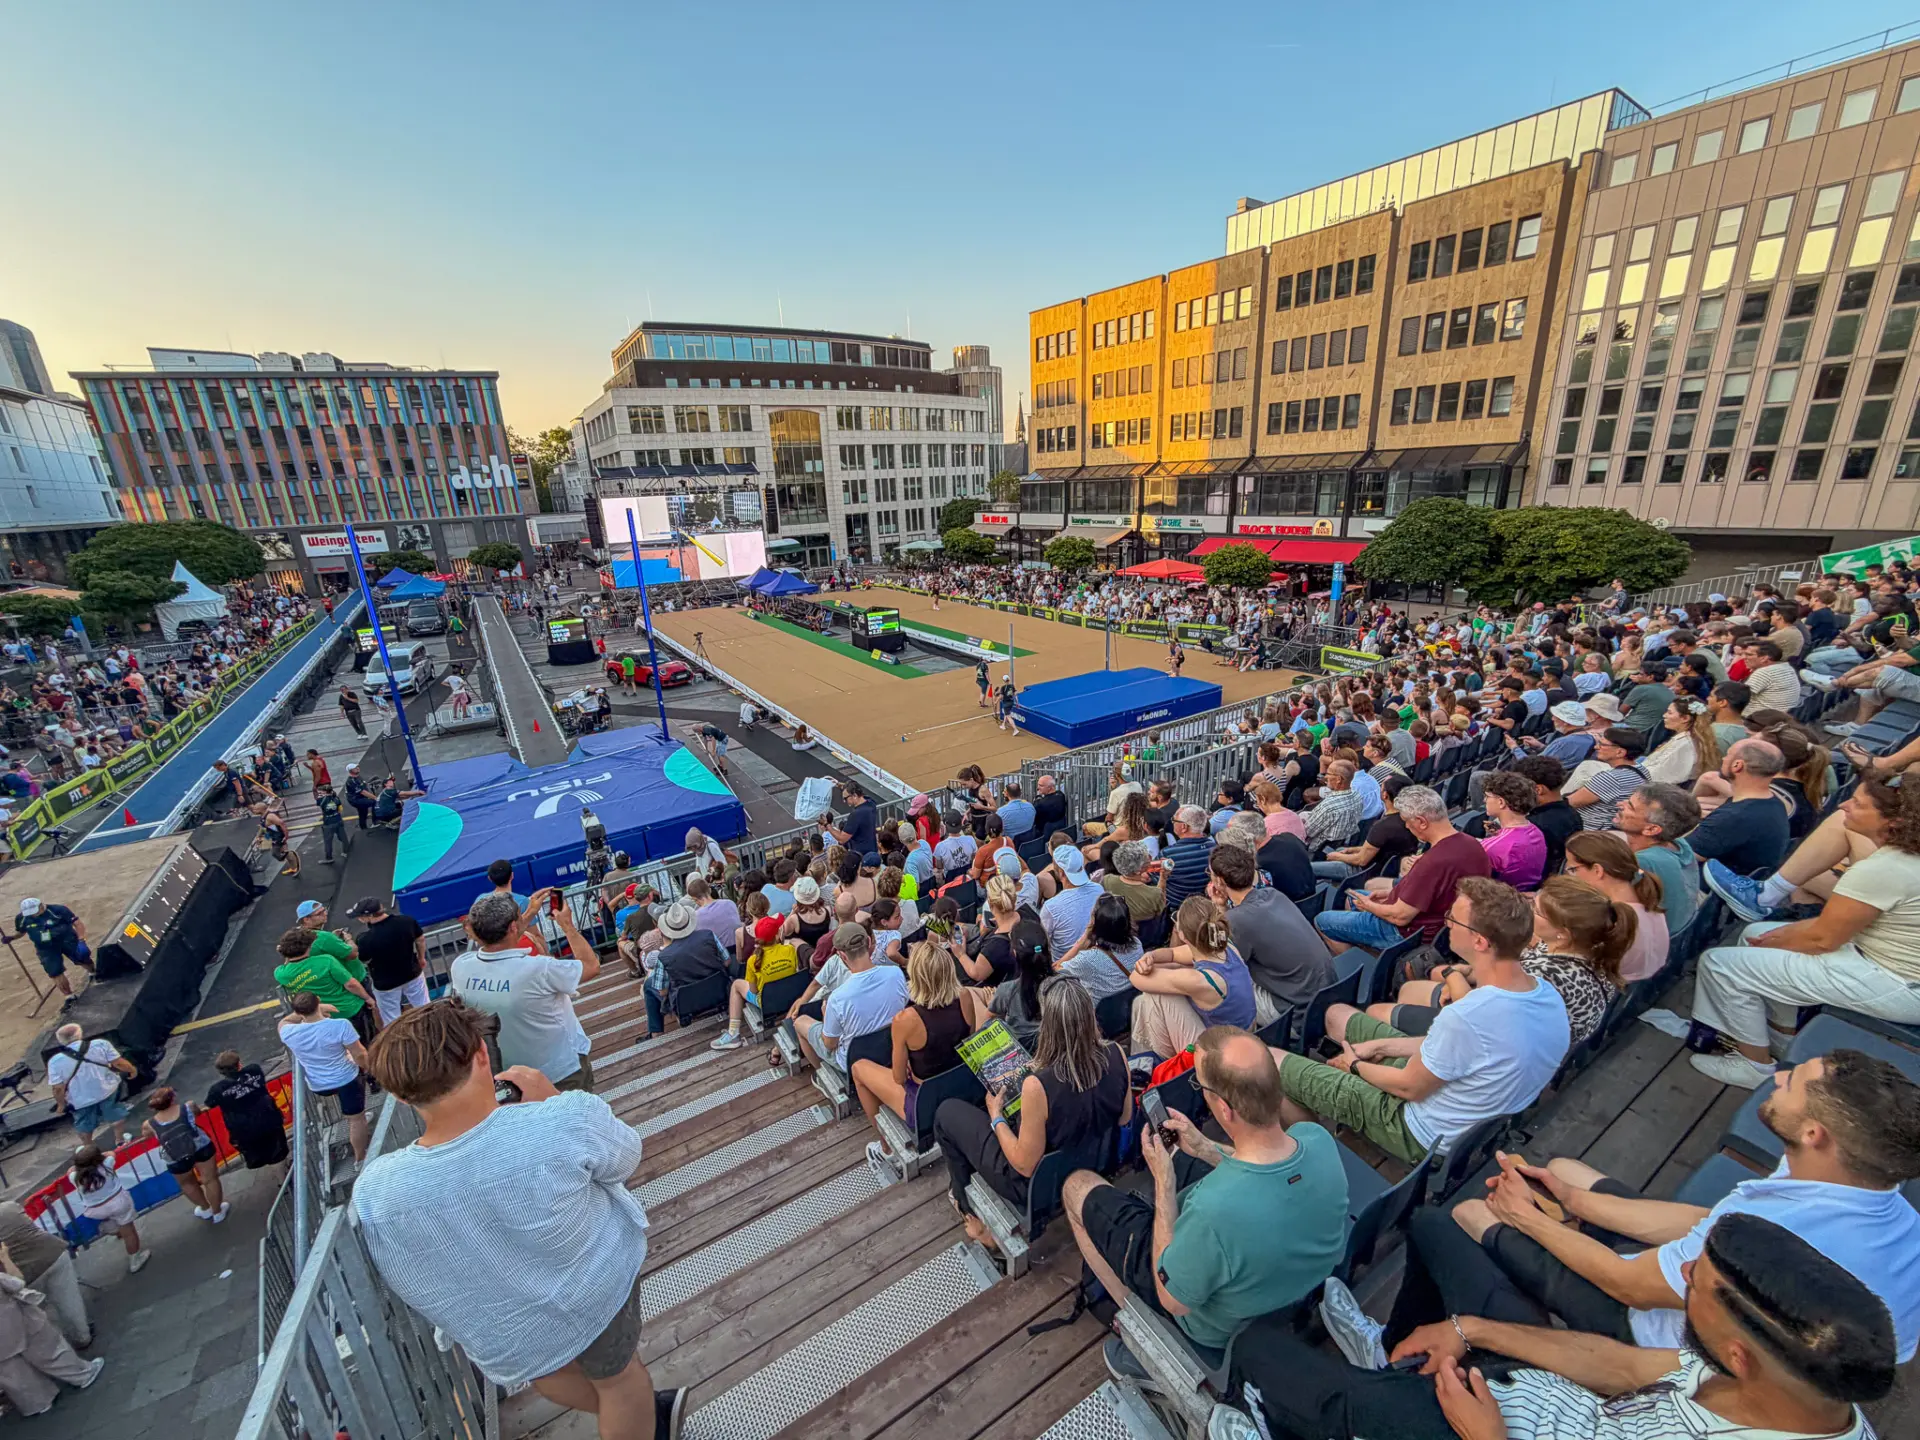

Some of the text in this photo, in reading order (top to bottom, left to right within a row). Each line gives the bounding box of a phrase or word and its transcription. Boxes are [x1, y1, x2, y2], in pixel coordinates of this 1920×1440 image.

[1238, 524, 1313, 535] BLOCK HOUSE
[307, 535, 376, 547] Weingaten
[507, 772, 612, 802] FISU
[192, 852, 200, 860] 5
[178, 873, 186, 881] 6
[161, 896, 170, 906] 7
[143, 924, 152, 933] 8
[286, 969, 312, 987] leißige
[465, 977, 511, 992] ITALIA
